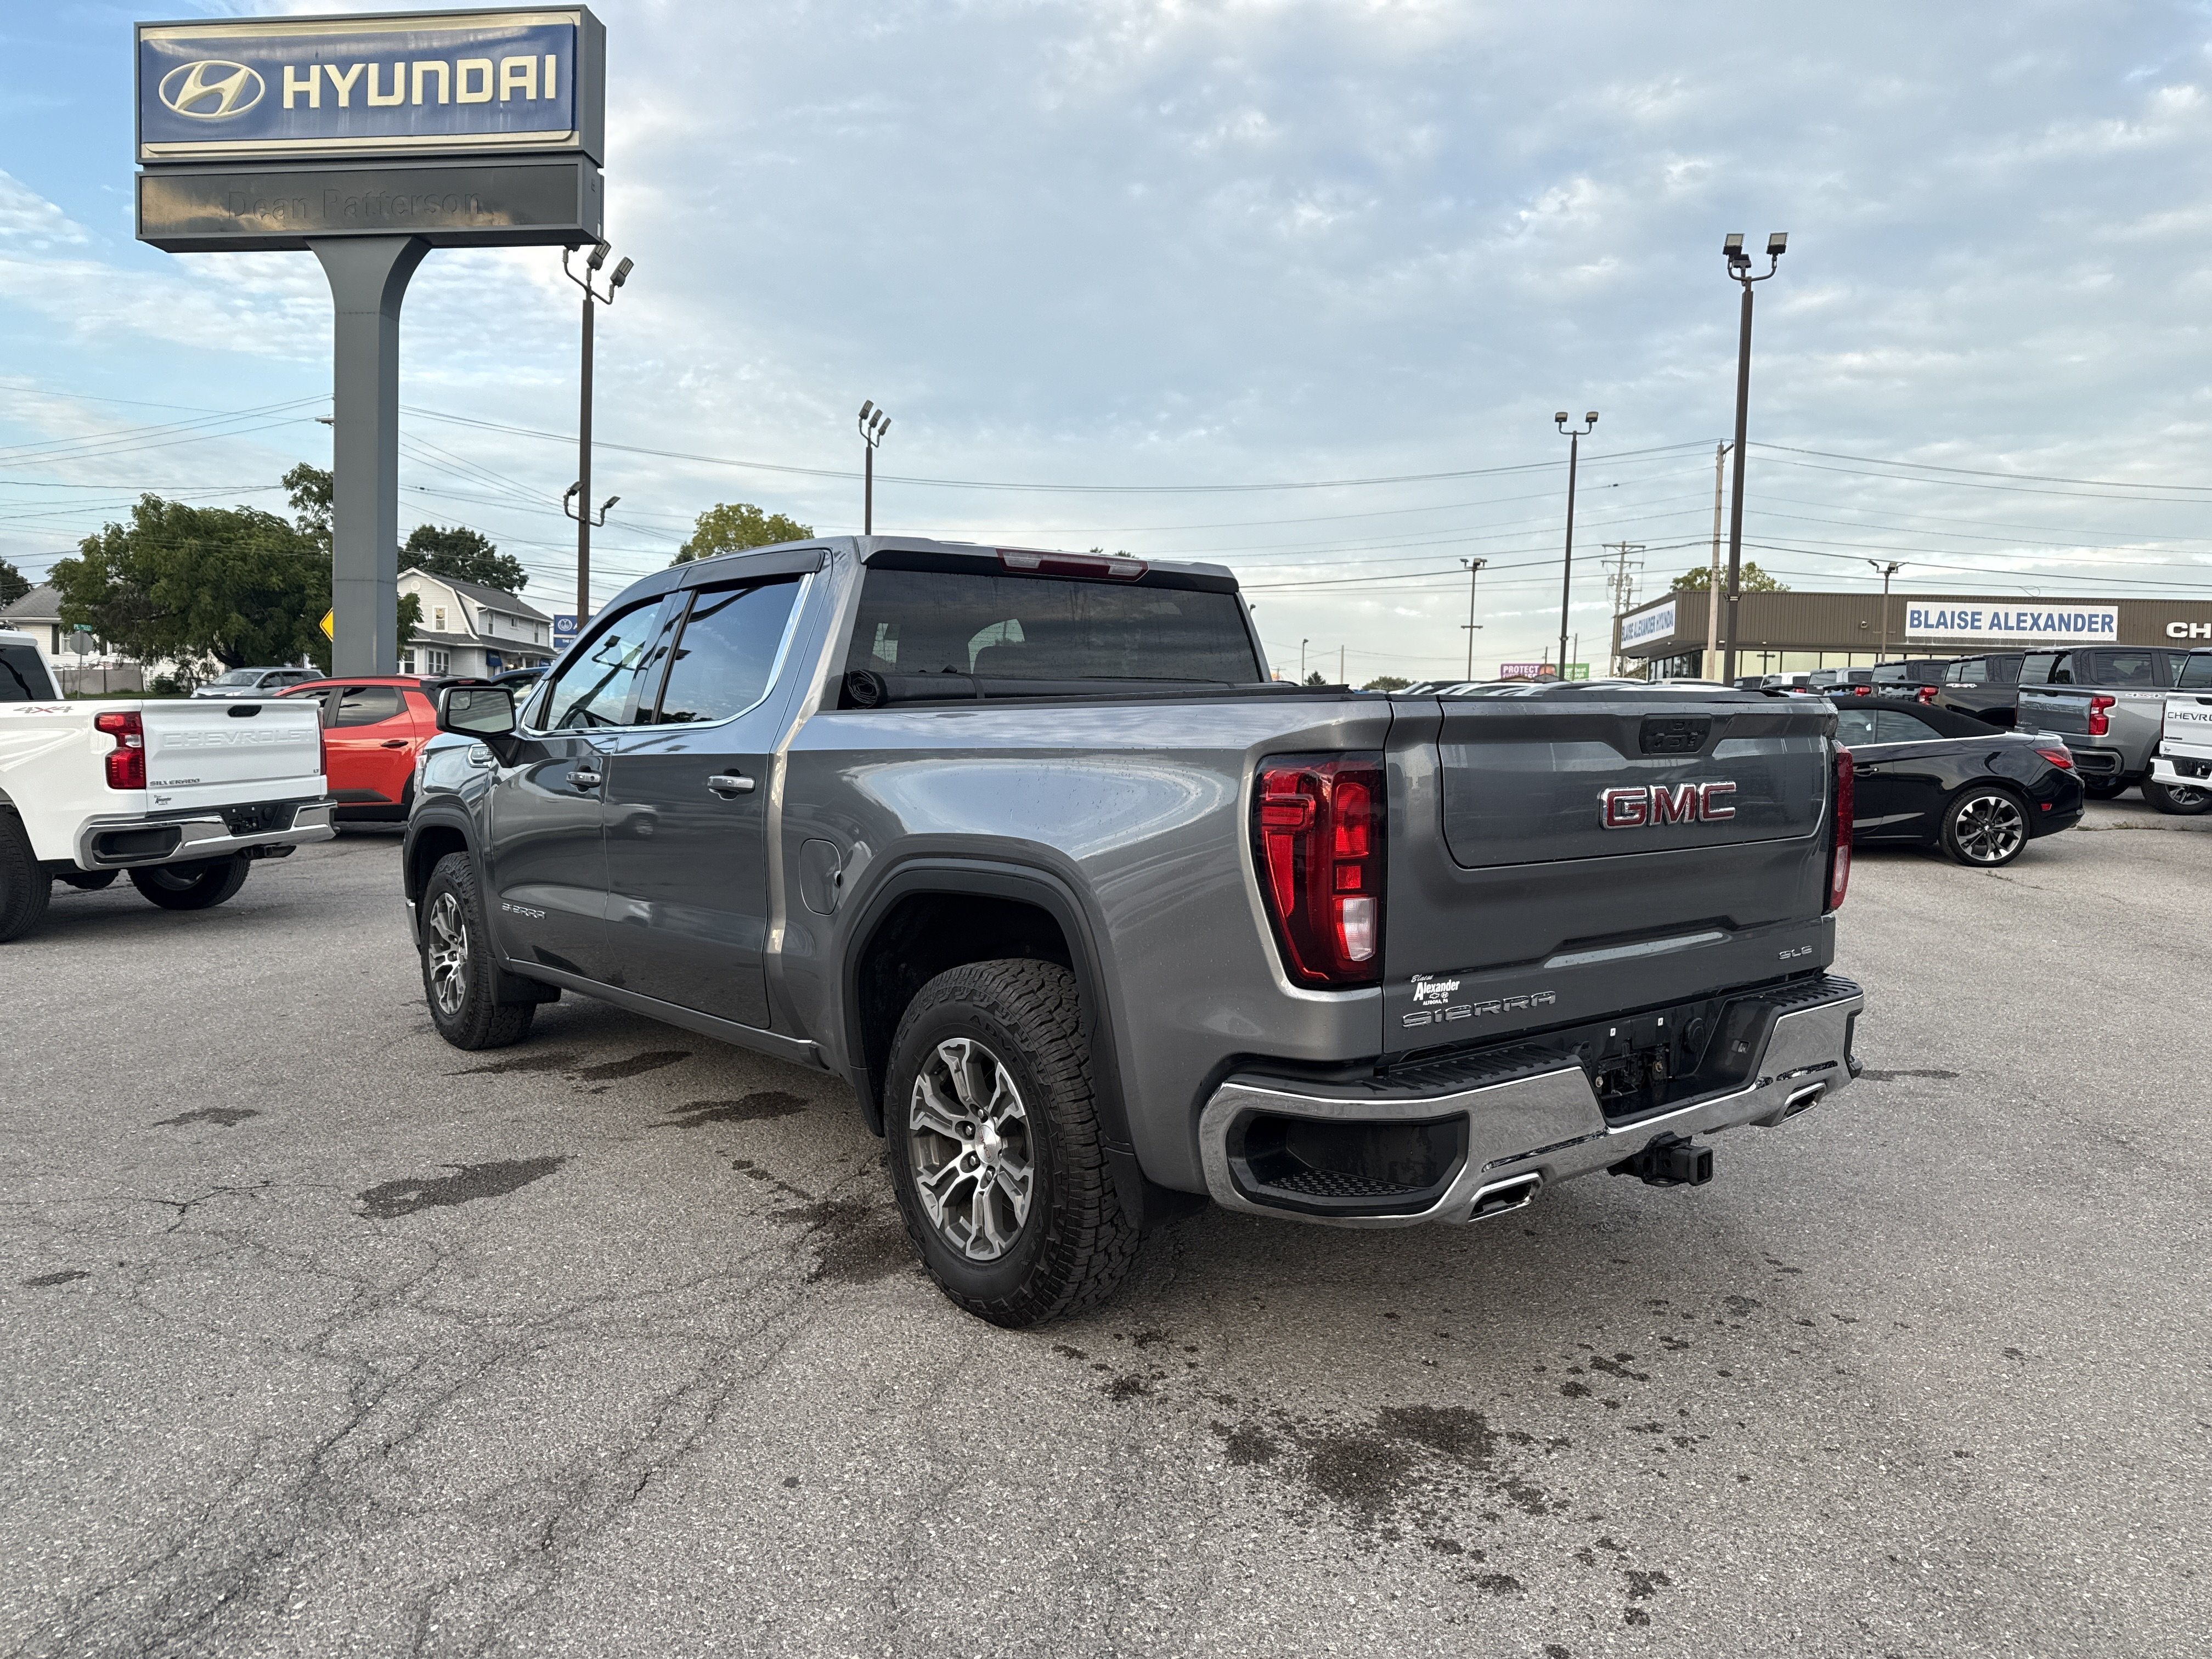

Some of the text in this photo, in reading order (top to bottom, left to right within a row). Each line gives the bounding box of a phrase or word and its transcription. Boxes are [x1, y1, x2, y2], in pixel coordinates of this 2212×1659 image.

[283, 54, 556, 109] HYUNDAI
[228, 189, 482, 220] Dean Patterson
[1622, 609, 1673, 642] BLAISE ALEXANDER HYUNDAI
[1909, 610, 2114, 633] BLAISE ALEXANDER
[2166, 622, 2211, 639] CH
[163, 729, 313, 747] CHEVROLET
[149, 778, 200, 786] SILVERADO
[1598, 781, 1737, 830] GMC
[502, 902, 545, 919] SIERRA
[1779, 945, 1813, 960] SLE
[1413, 979, 1460, 1001] Alexander
[1402, 990, 1556, 1028] SIERRA
